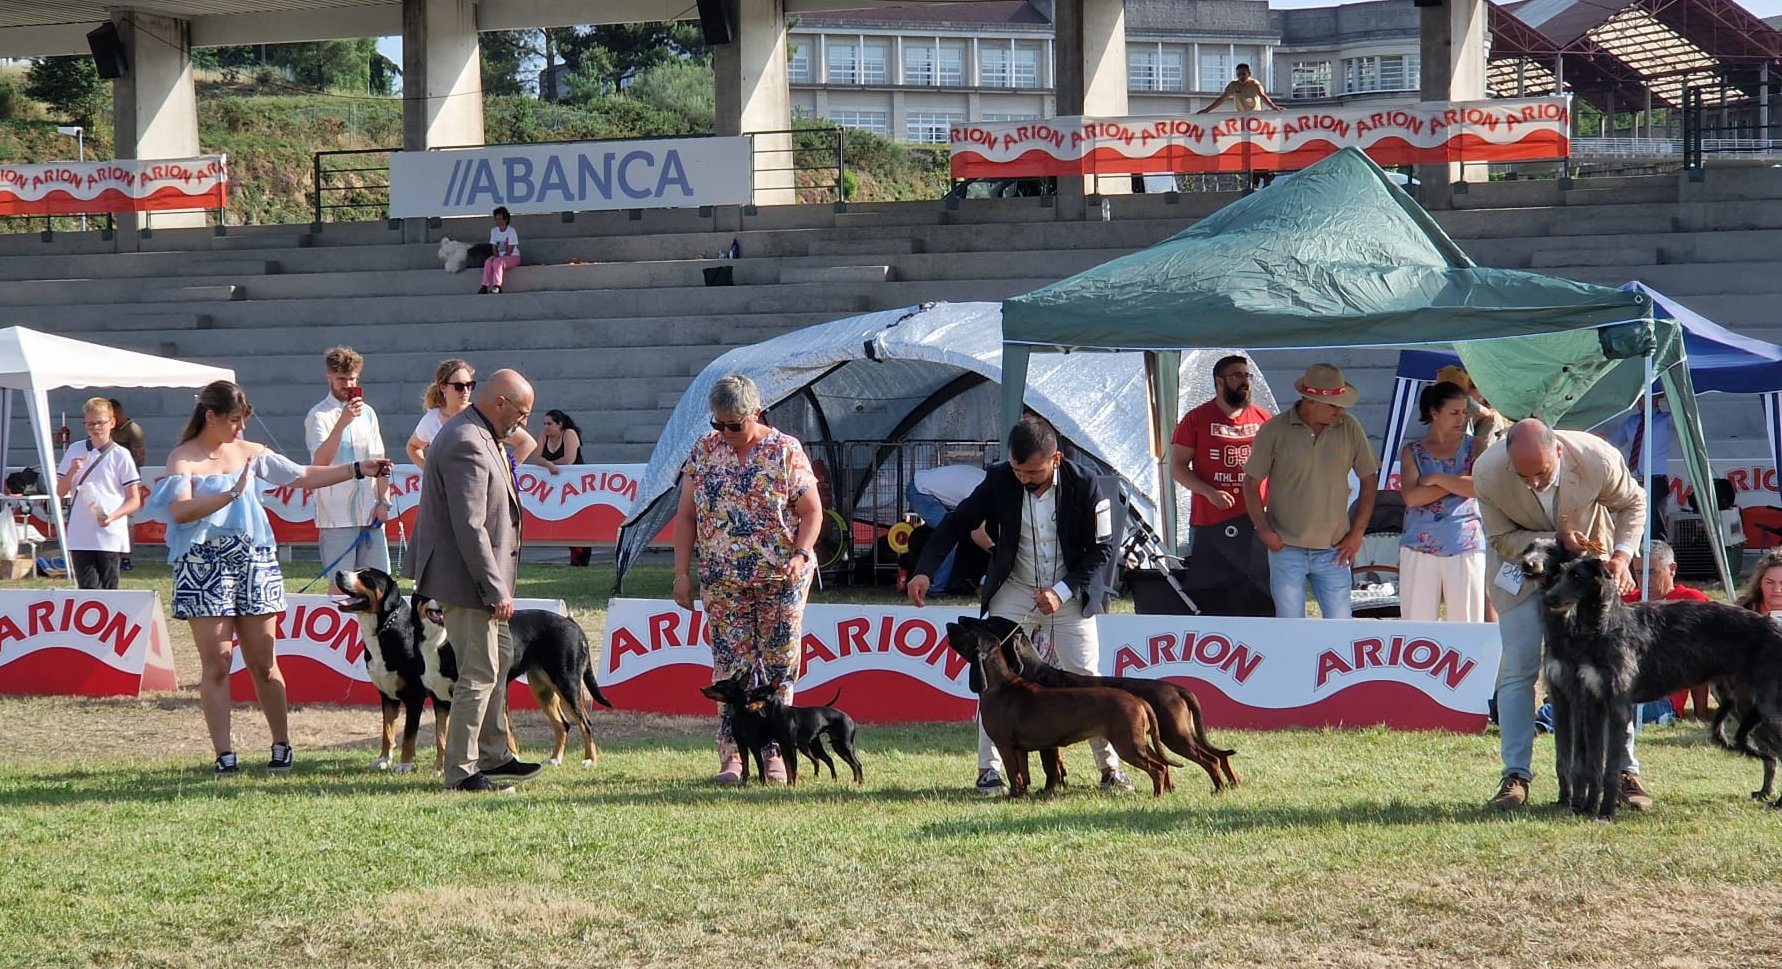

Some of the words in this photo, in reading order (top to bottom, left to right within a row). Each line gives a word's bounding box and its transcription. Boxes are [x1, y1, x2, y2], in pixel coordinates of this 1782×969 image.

[951, 127, 998, 151] RION
[1004, 125, 1065, 150] ARION
[1071, 122, 1136, 148] ARION
[1141, 120, 1205, 146] ARION
[1211, 117, 1277, 144] ARION
[1283, 114, 1350, 141] ARION
[1356, 111, 1423, 139] ARION
[1429, 107, 1499, 136] ARION
[0, 169, 28, 190] ION
[32, 168, 83, 191] ARION
[86, 166, 135, 190] ARION
[140, 164, 192, 188] ARION
[0, 598, 142, 657] ARION
[275, 605, 367, 666] ION
[609, 610, 711, 674] ARI
[1114, 632, 1264, 685] ARION
[1315, 636, 1476, 690] ARION
